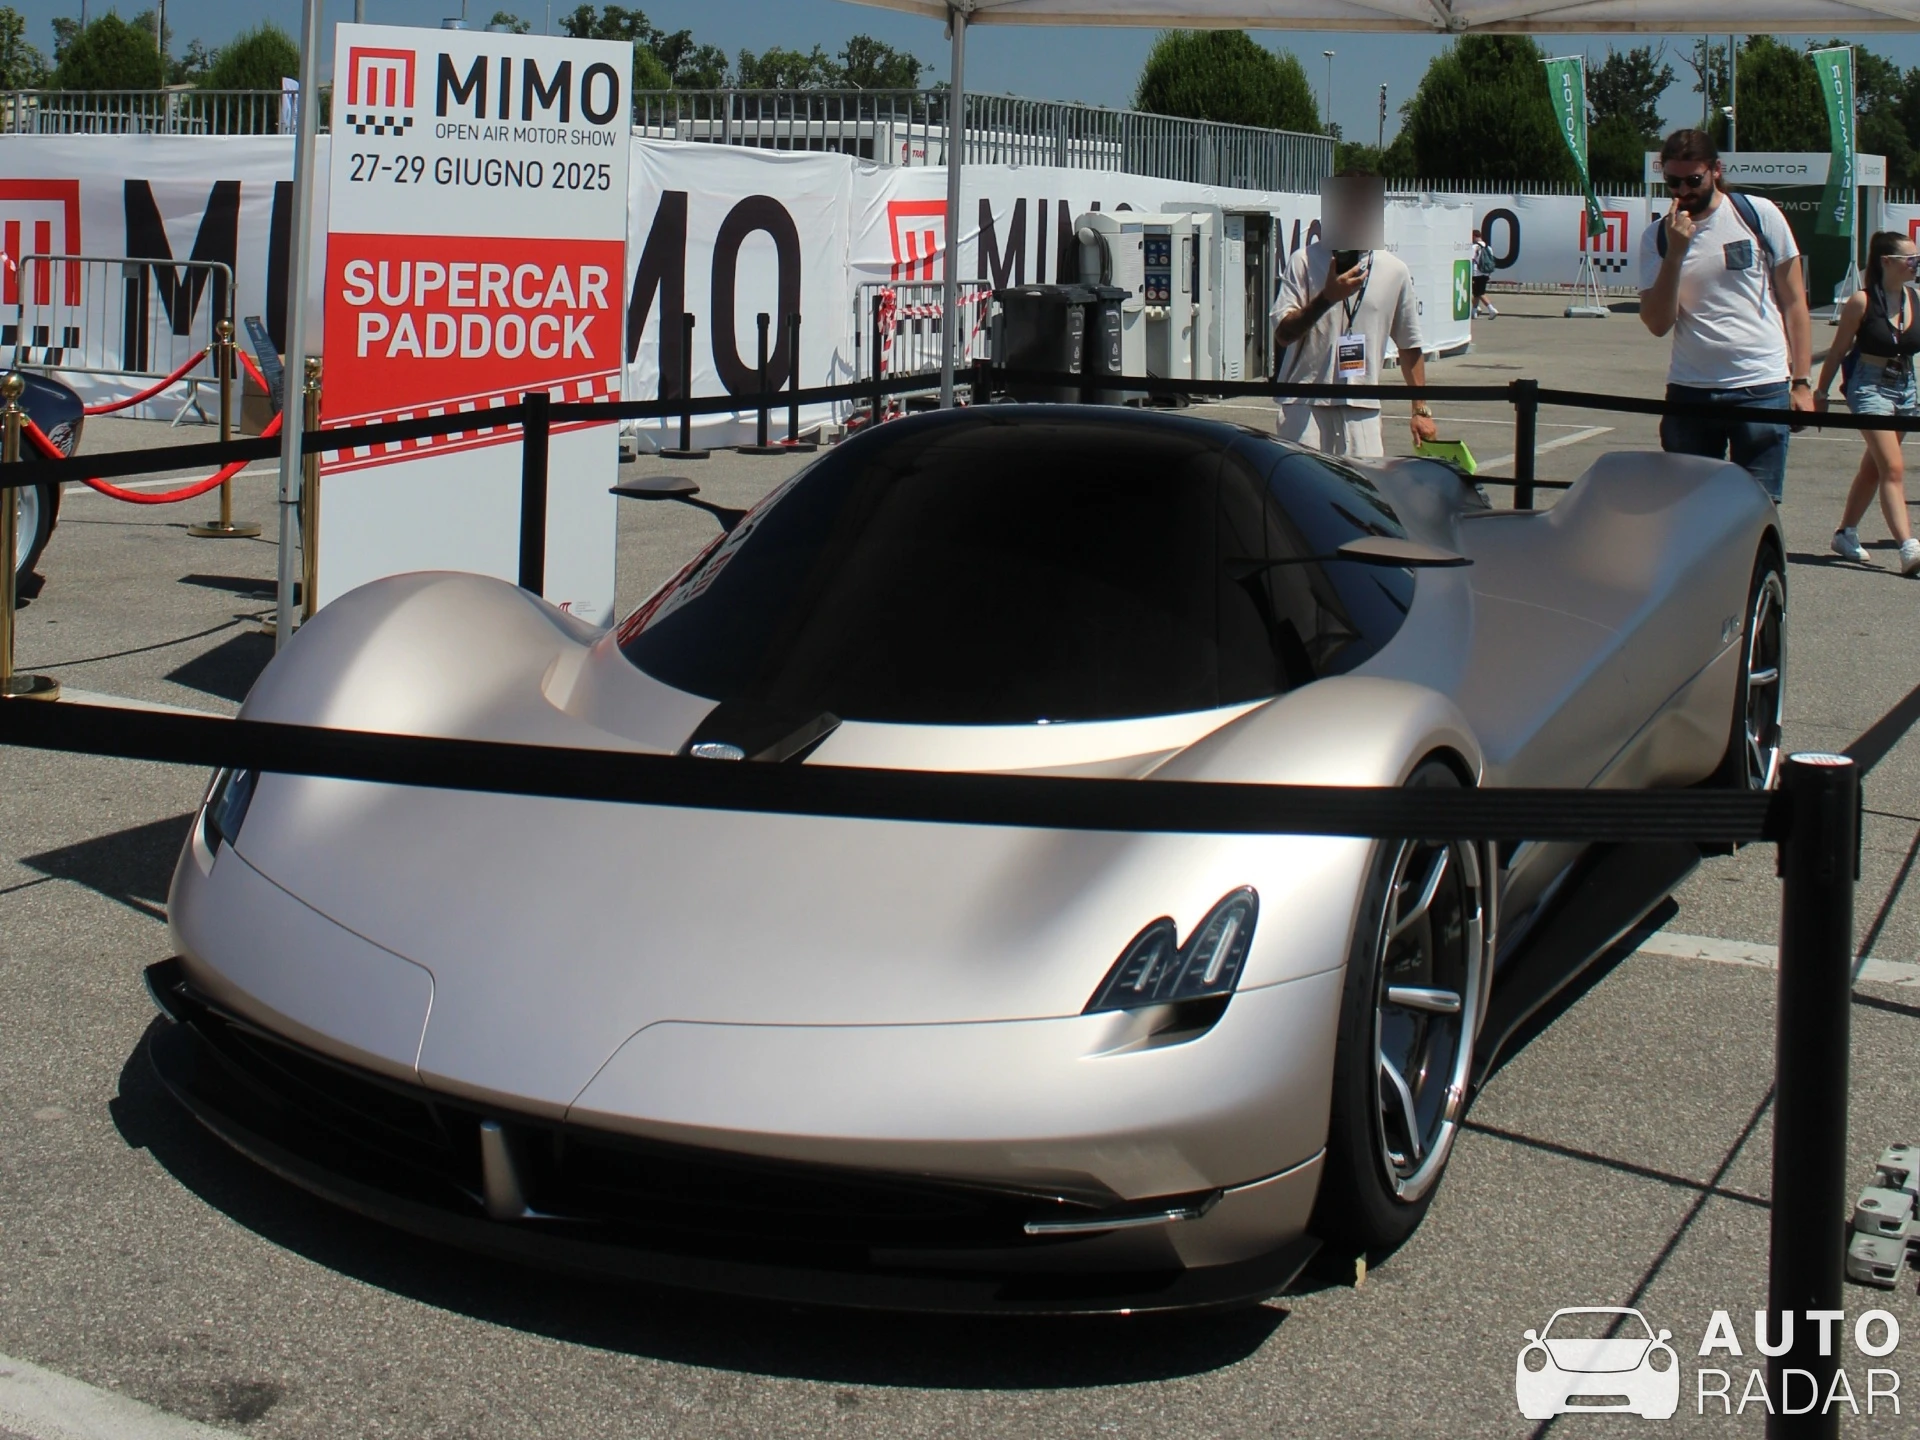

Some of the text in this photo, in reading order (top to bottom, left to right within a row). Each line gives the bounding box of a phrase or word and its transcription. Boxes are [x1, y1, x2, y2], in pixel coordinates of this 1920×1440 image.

[435, 53, 620, 125] MIMO
[435, 123, 617, 146] OPEN AIR MOTOR SHOW
[350, 153, 611, 191] 27-29 GIUGNO 2025
[1720, 164, 1808, 174] EAPMOTOR
[342, 259, 609, 309] SUPERCAR
[356, 312, 596, 359] PADDOCK
